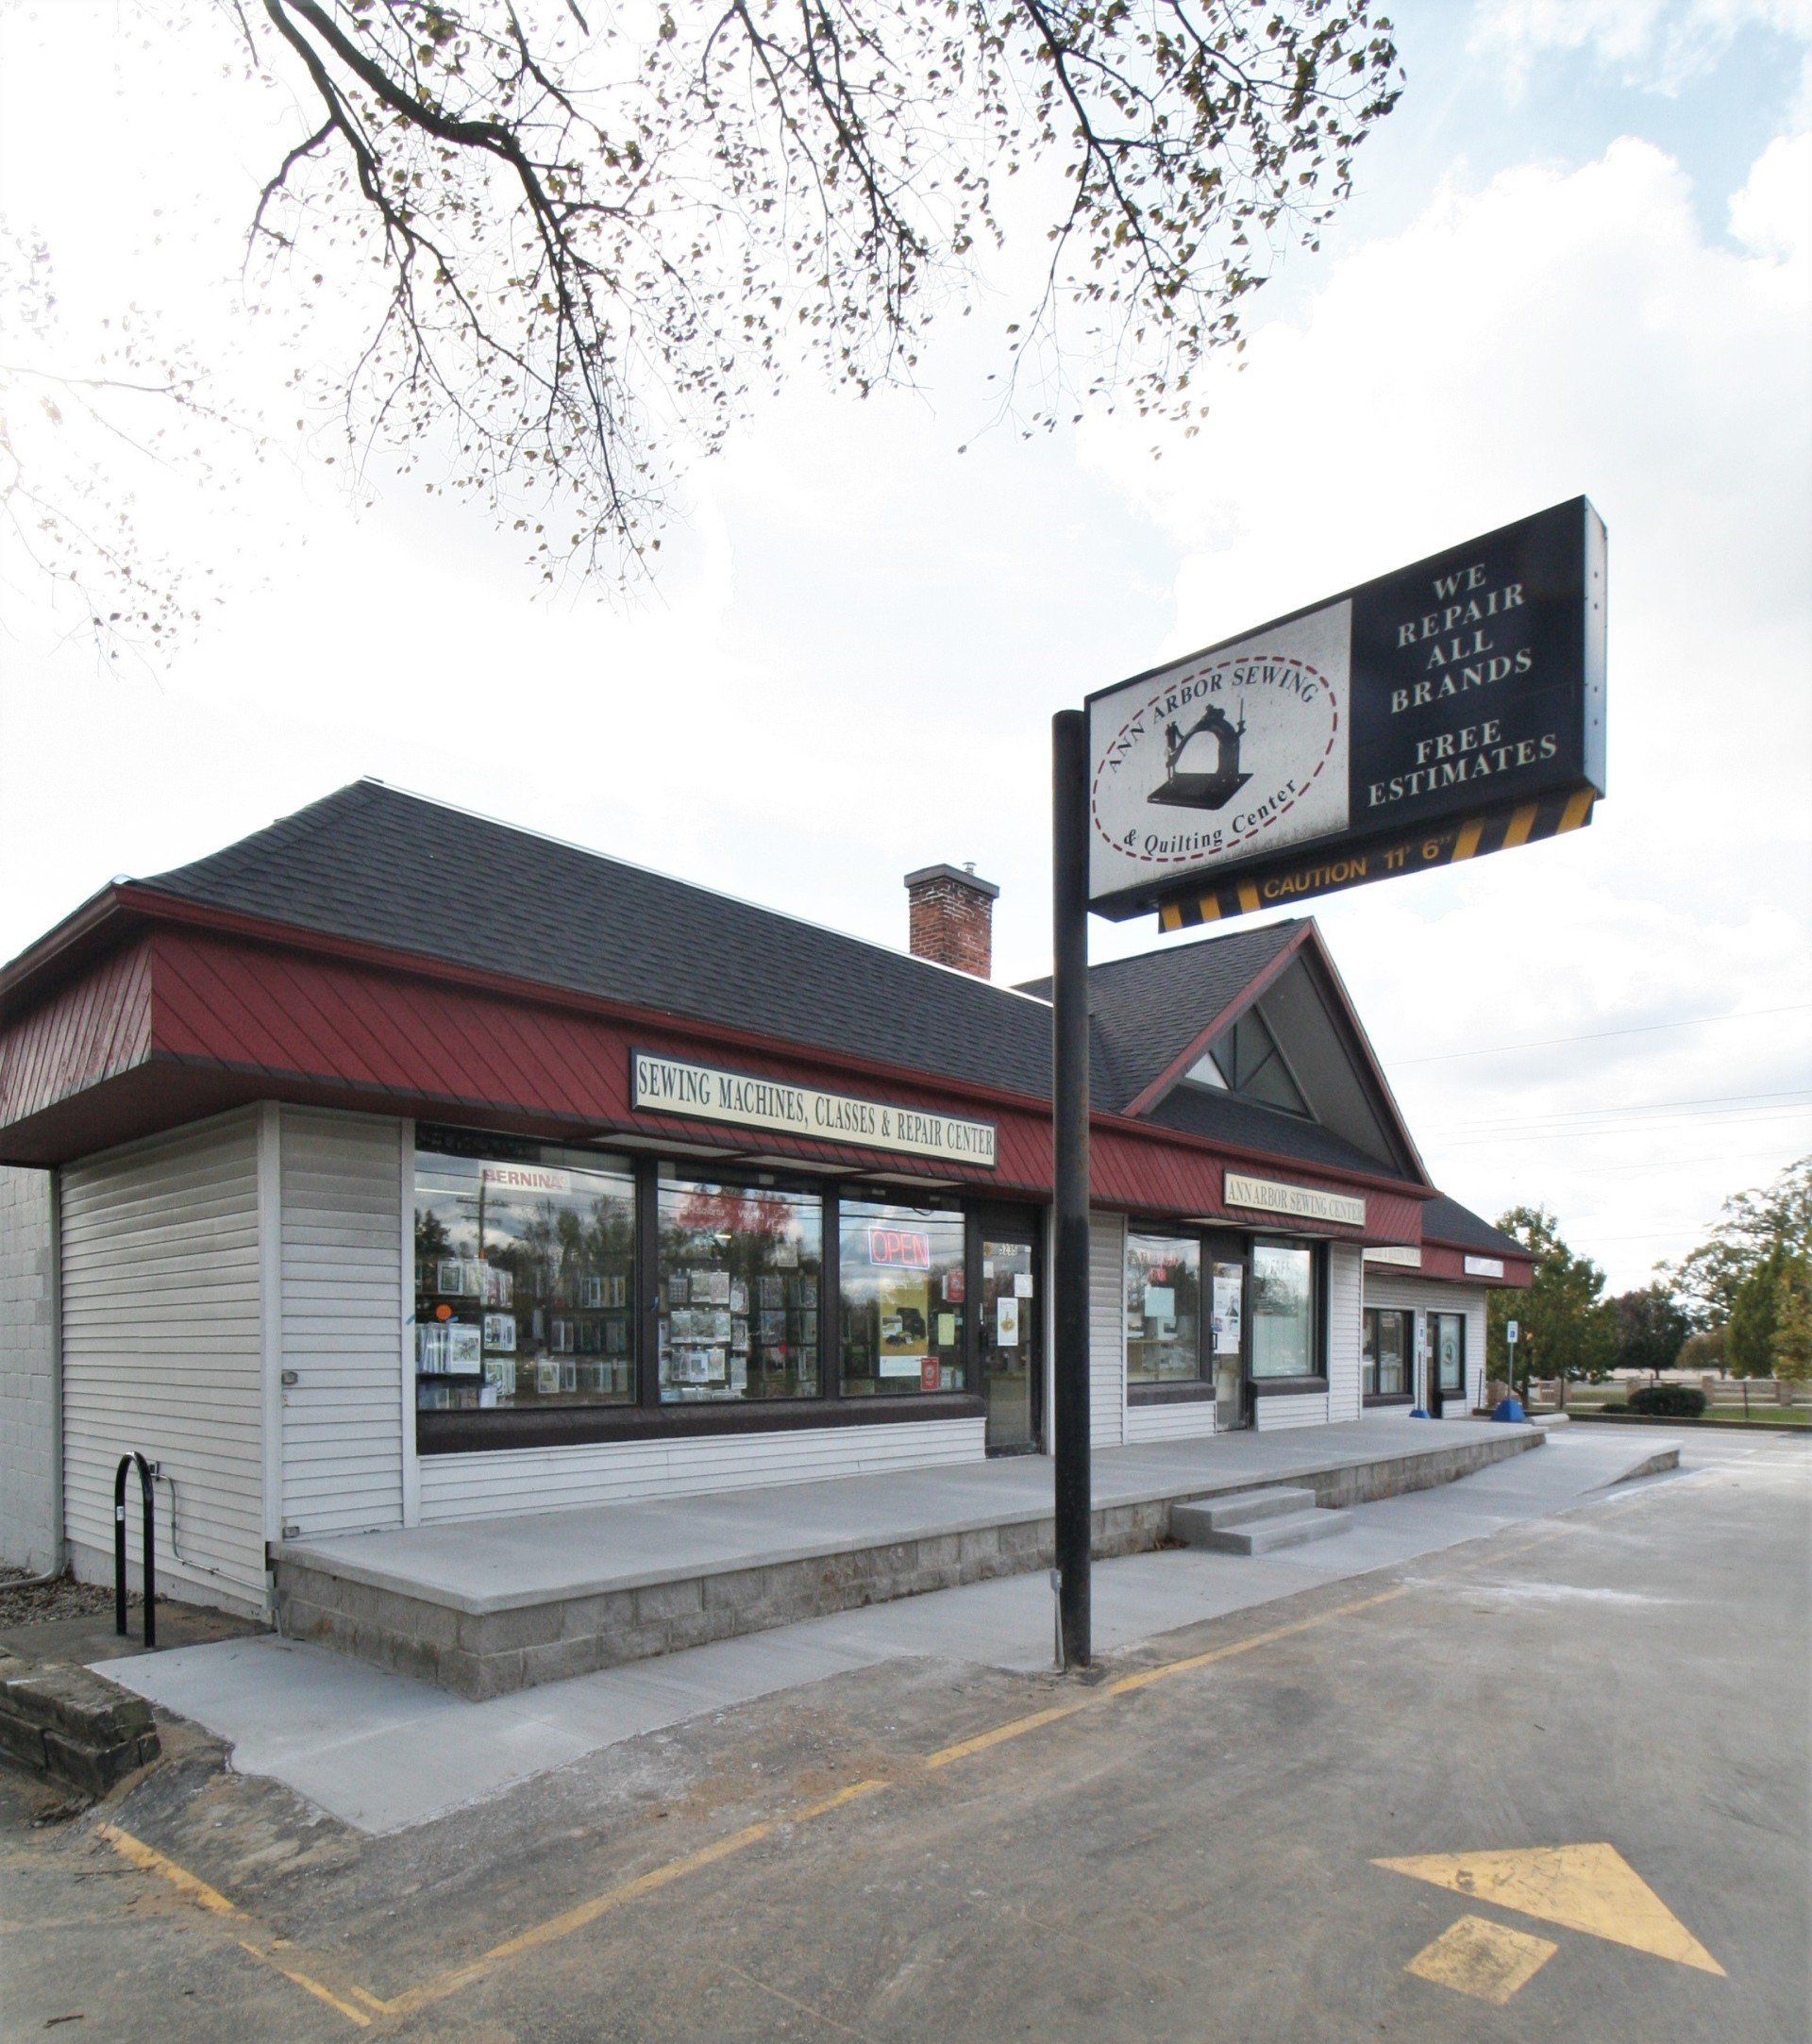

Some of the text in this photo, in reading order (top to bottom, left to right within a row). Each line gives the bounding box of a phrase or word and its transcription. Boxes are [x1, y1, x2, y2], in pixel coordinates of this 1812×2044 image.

[1433, 563, 1485, 600] WE
[1398, 582, 1525, 648] REPAIR
[1426, 629, 1494, 670] ALL
[1391, 647, 1532, 714] BRANDS
[1109, 665, 1318, 774] ANN ARBOR SEWING
[1416, 719, 1502, 765] FREE
[1368, 733, 1557, 808] ESTIMATES
[1124, 779, 1296, 854] & Quilting Center
[1264, 856, 1367, 898] CAUTION
[638, 1060, 994, 1156] SEWING MACHINES, CLASSES & REPAIR CENTER
[483, 1169, 563, 1190] BERNINA
[1228, 1181, 1364, 1222] ANN ARBOR SEWING CENTER
[871, 1230, 929, 1265] OPEN
